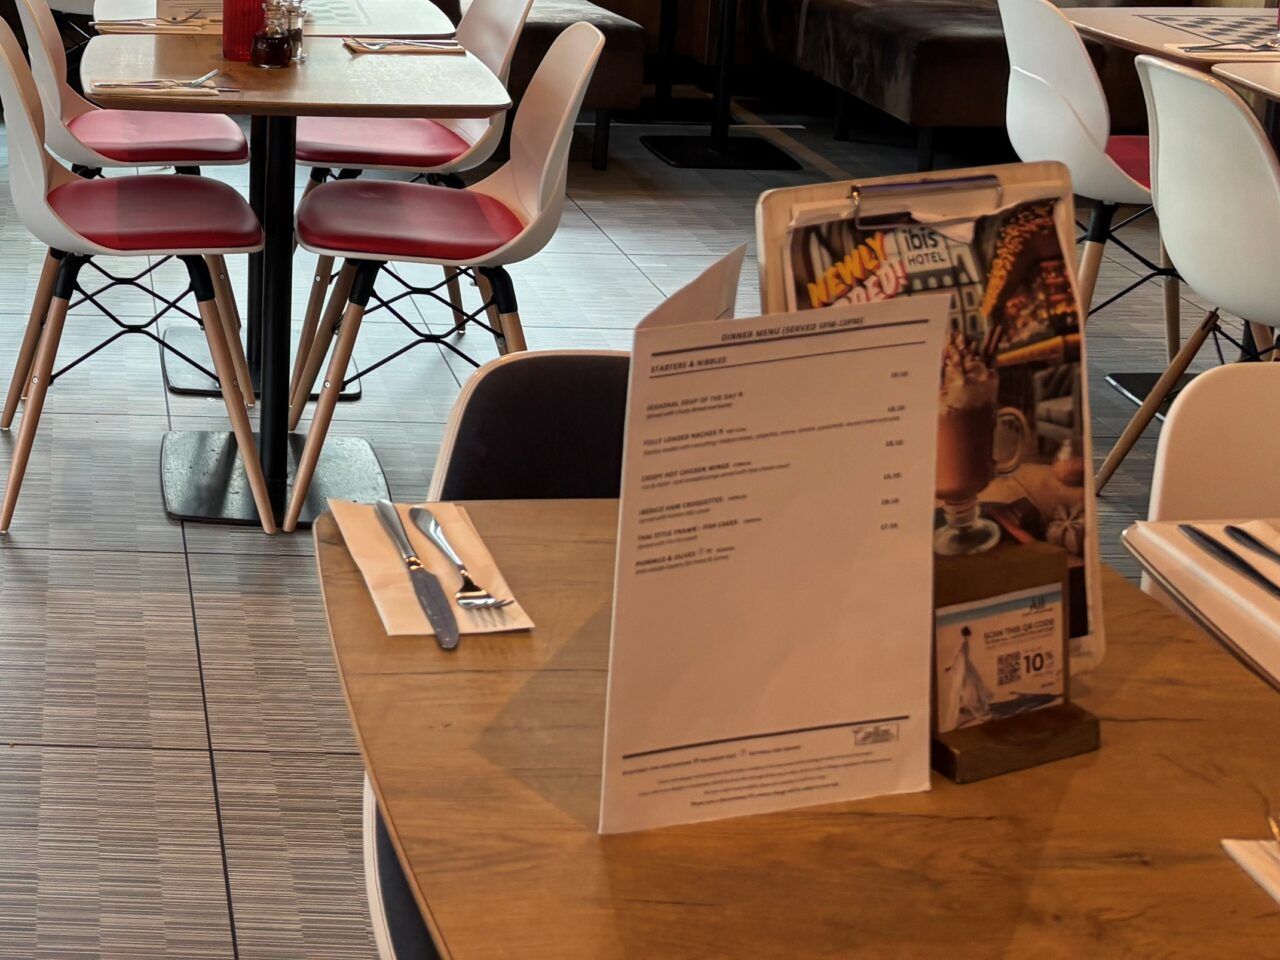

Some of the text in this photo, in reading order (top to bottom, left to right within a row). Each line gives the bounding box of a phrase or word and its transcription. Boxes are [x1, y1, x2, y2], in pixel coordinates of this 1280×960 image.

[904, 228, 940, 251] ibis
[907, 253, 947, 266] HOTEL
[806, 231, 891, 310] NEWLY
[755, 326, 779, 337] MENU
[697, 355, 726, 366] NIBBLES
[1023, 652, 1045, 675] 10
